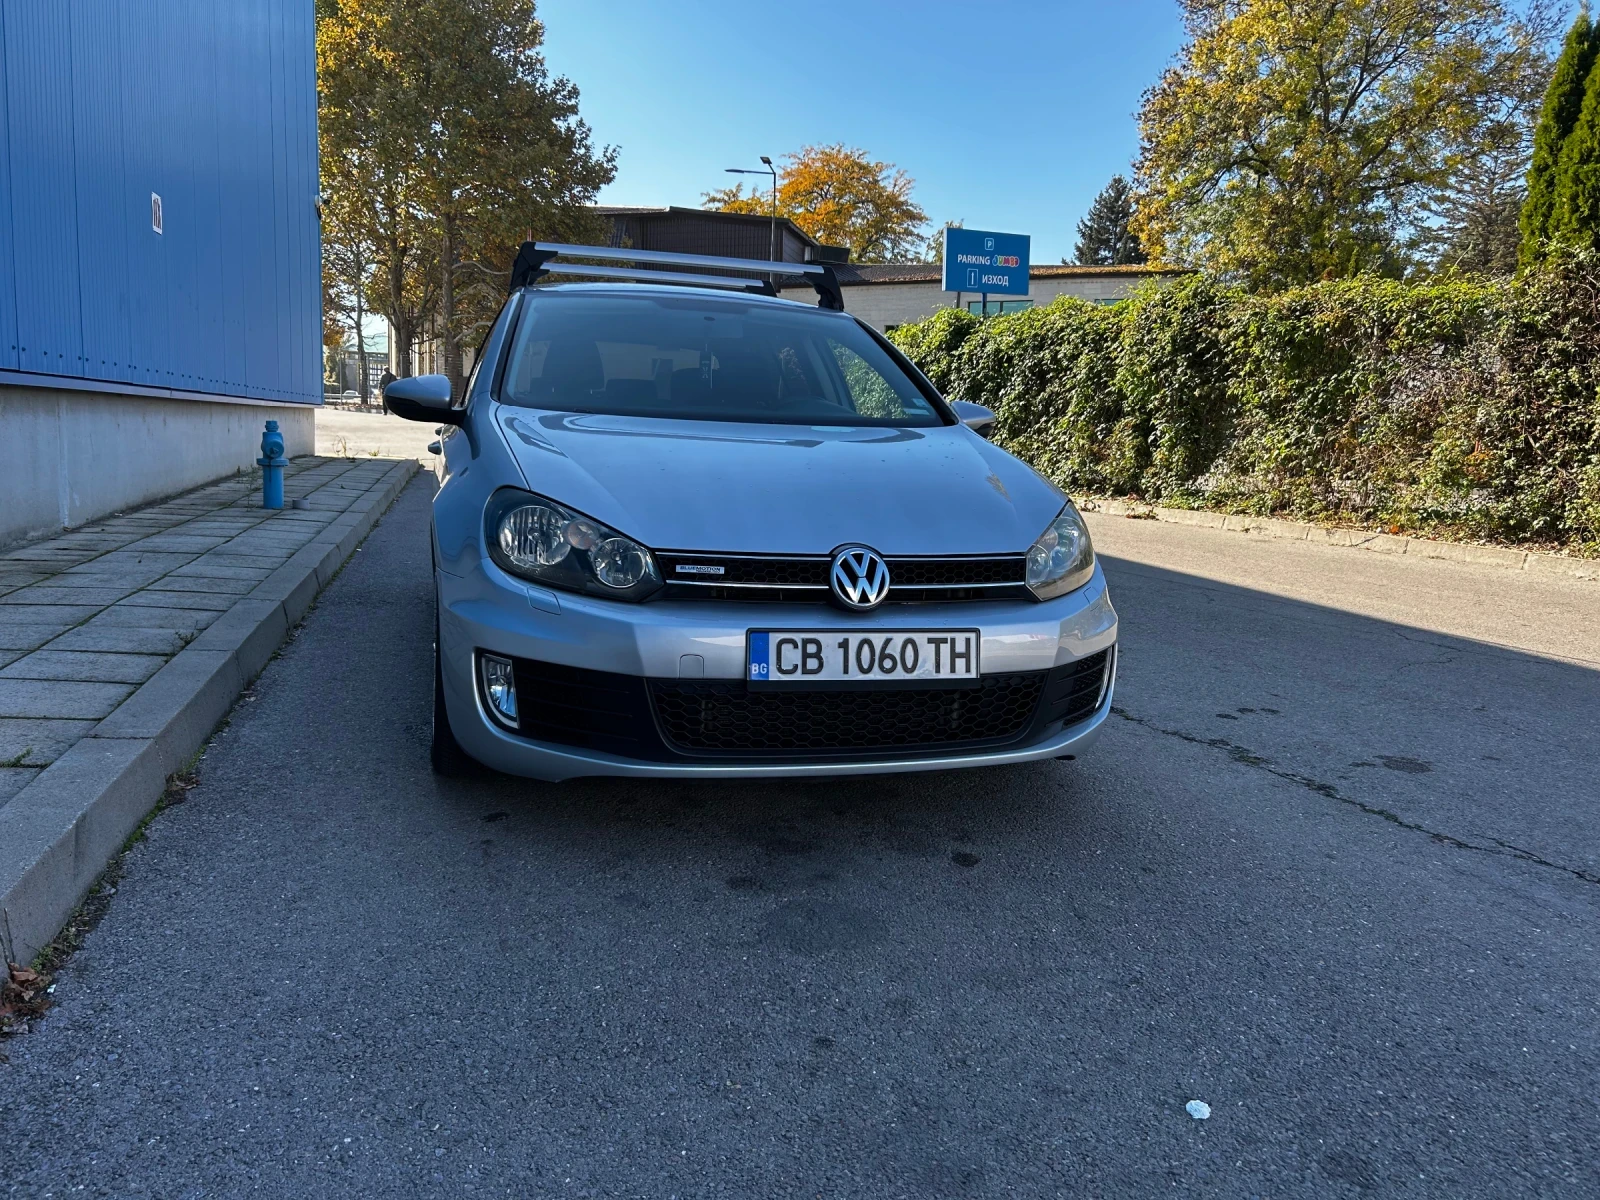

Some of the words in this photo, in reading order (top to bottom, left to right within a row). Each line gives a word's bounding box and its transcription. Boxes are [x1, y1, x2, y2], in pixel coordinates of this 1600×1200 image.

[957, 254, 991, 266] PARKING
[981, 274, 1009, 287] ИЗХОД
[775, 637, 824, 675] CB
[837, 637, 919, 675] 1060
[927, 637, 971, 674] TH
[751, 662, 768, 675] BG
